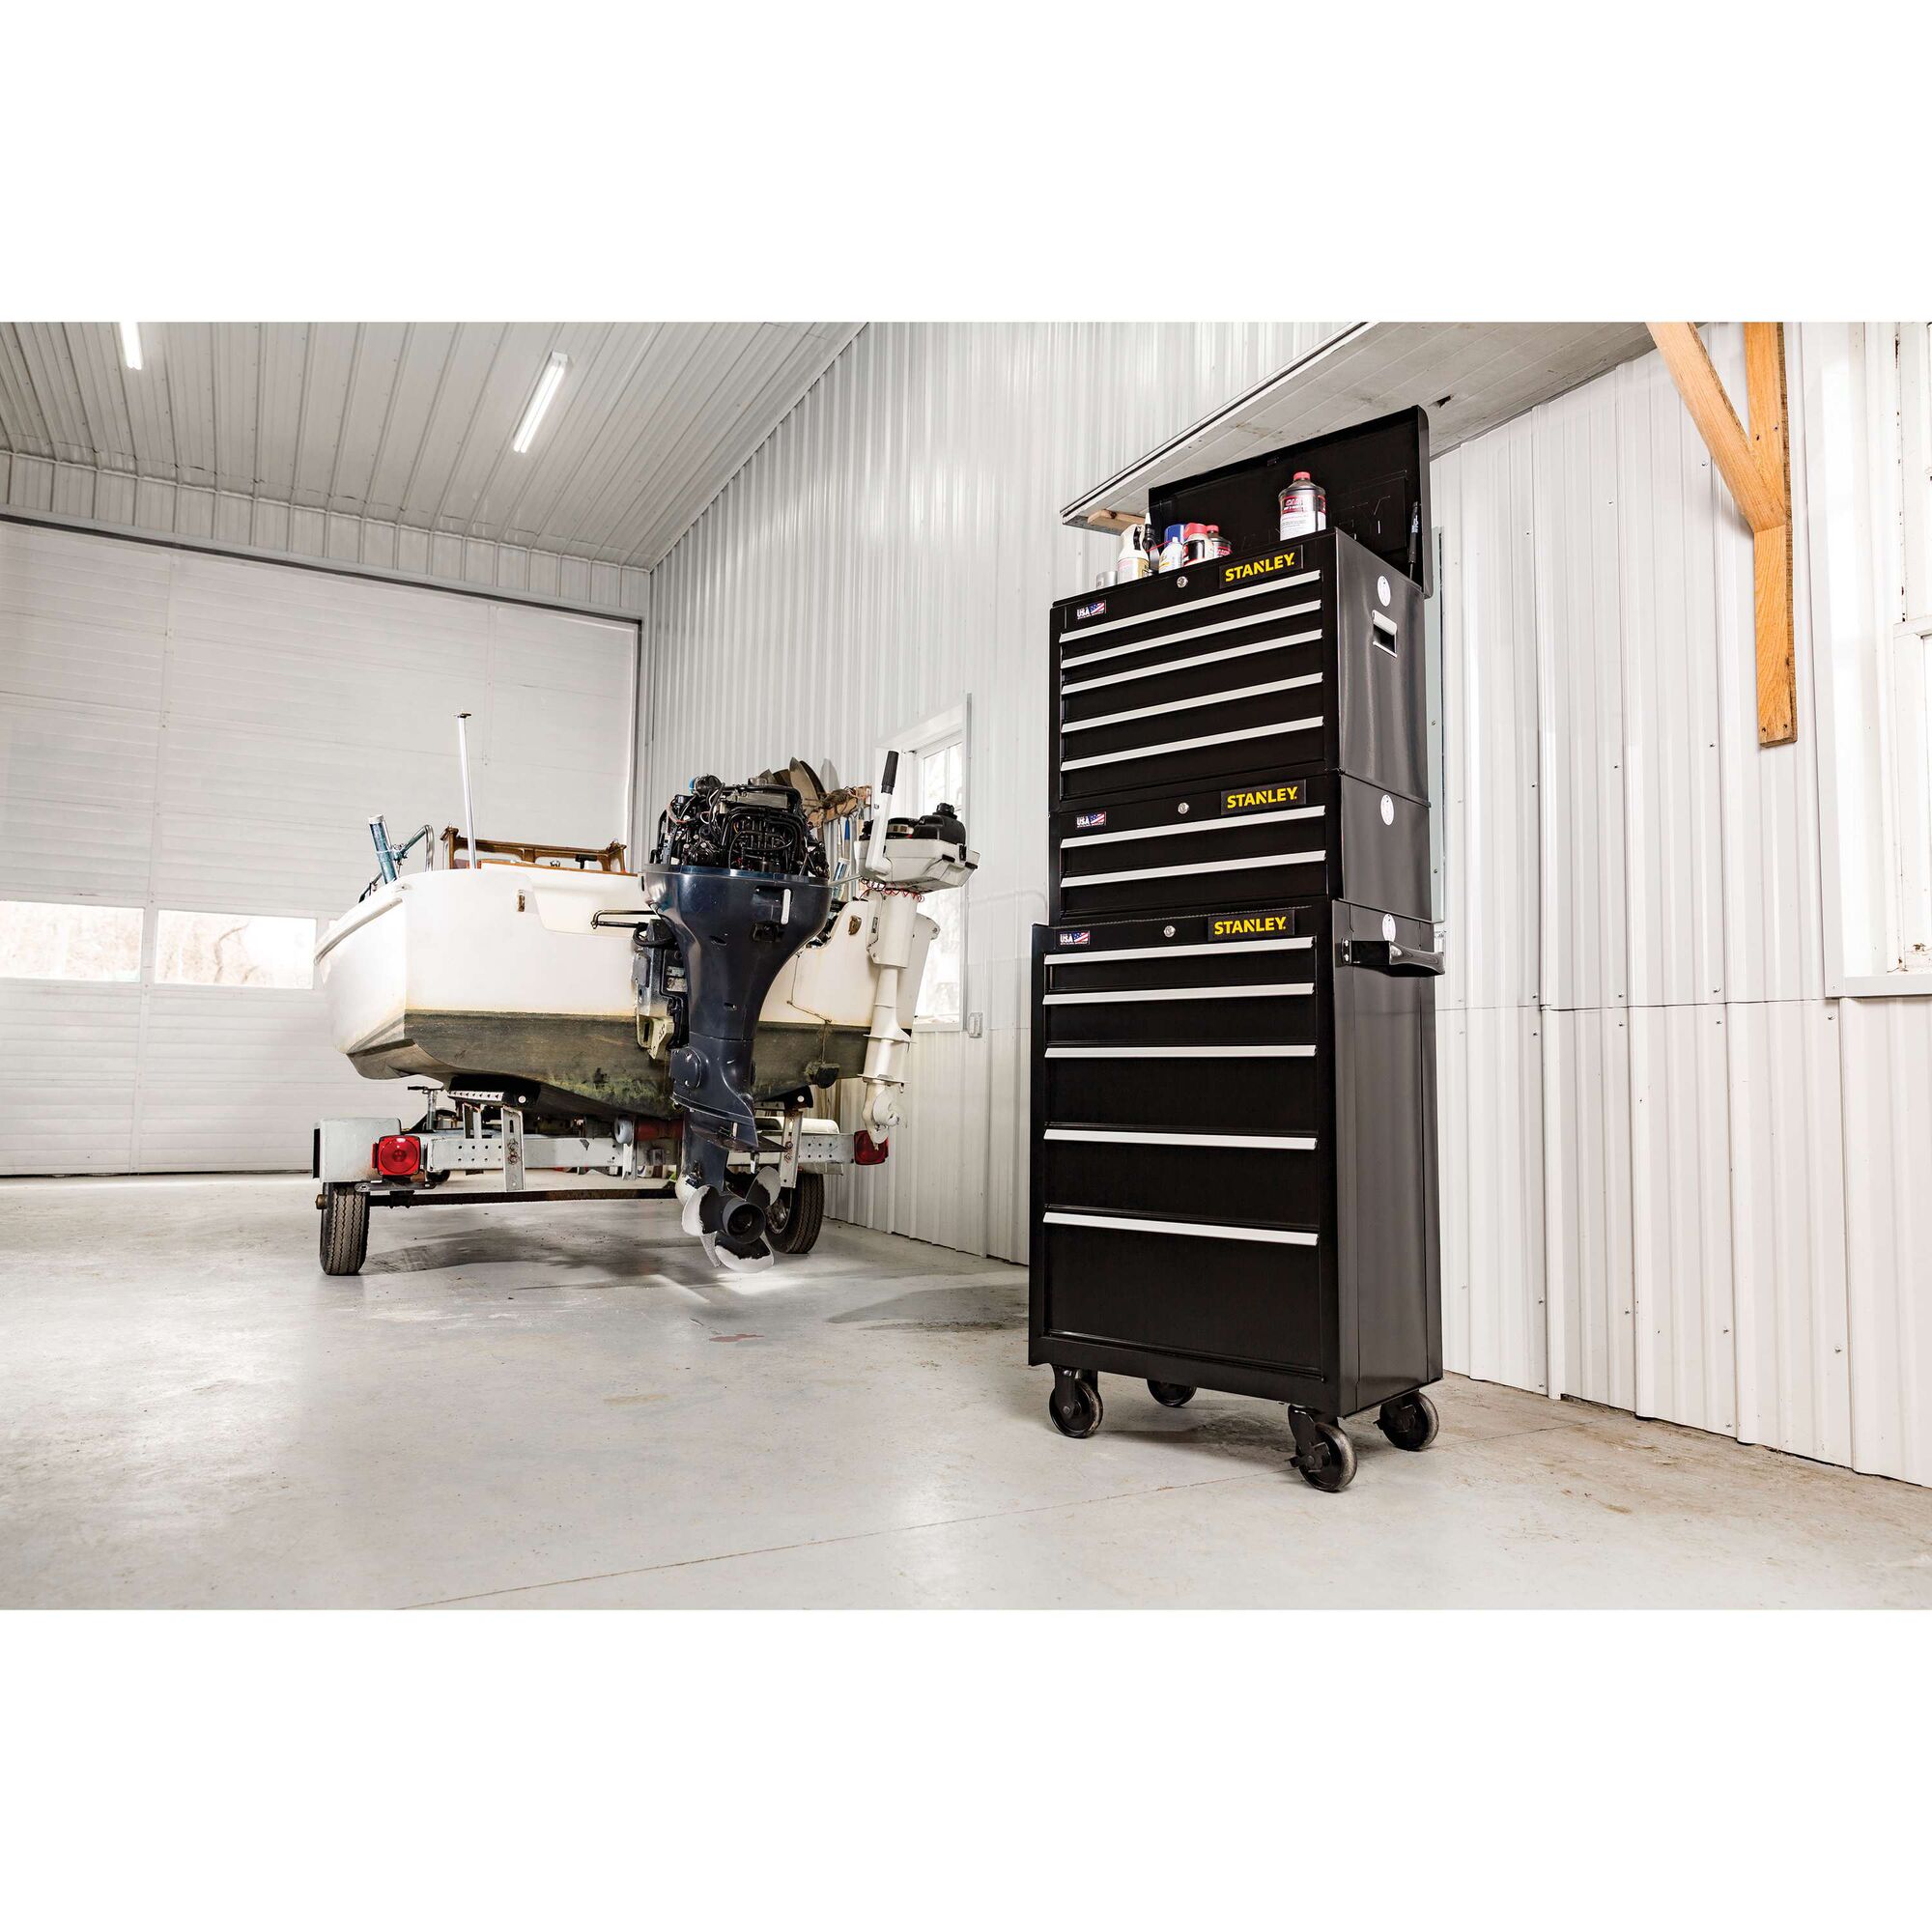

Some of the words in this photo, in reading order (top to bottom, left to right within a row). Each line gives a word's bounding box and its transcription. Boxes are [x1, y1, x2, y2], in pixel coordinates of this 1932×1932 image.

[1225, 553, 1295, 582] STANLEY
[1076, 607, 1091, 617] USA
[1227, 786, 1297, 809] STANLEY
[1076, 816, 1090, 826] USA
[1214, 917, 1286, 935] STANLEY
[1060, 933, 1073, 943] USA
